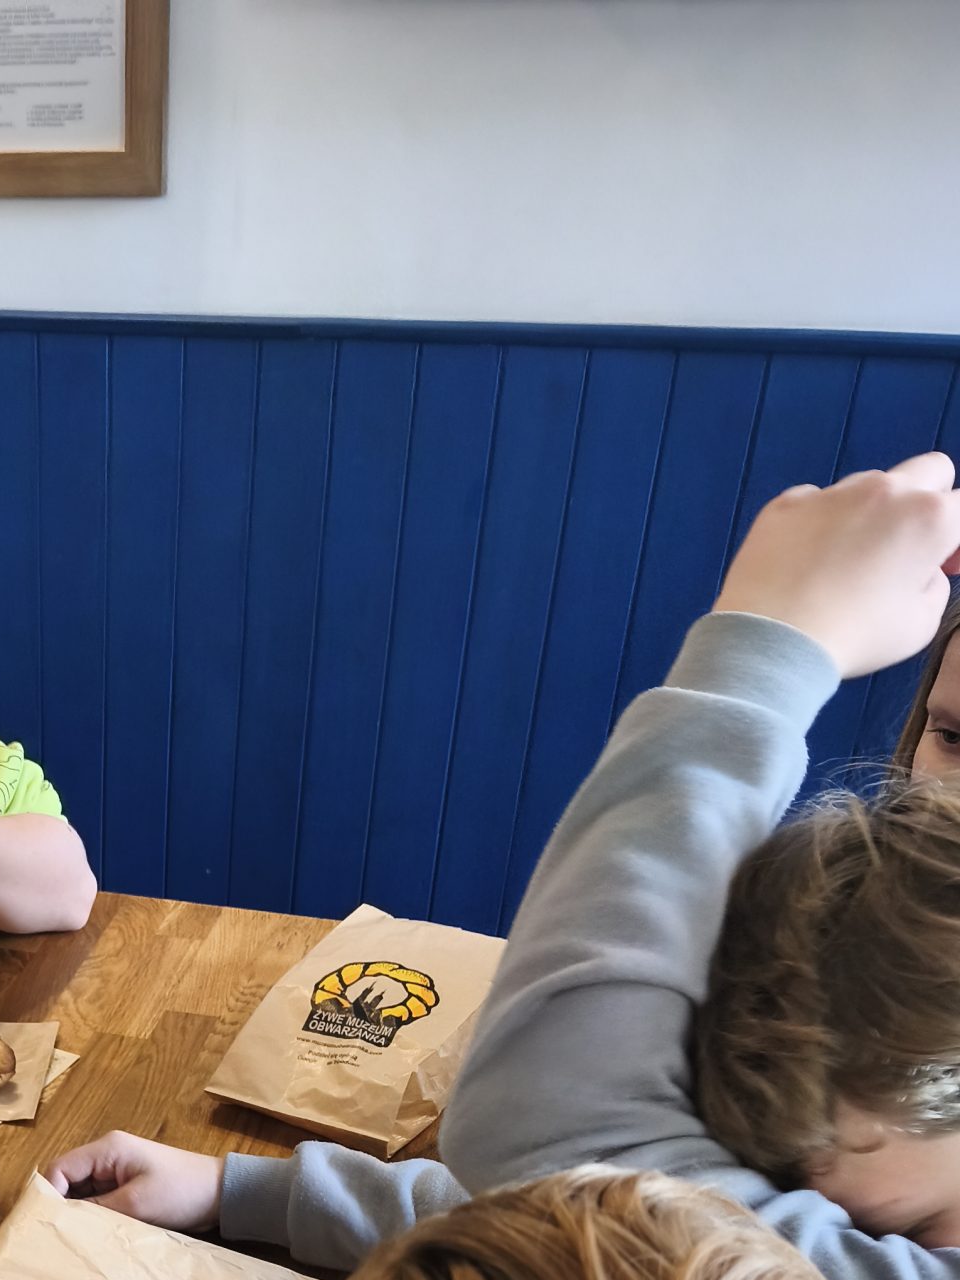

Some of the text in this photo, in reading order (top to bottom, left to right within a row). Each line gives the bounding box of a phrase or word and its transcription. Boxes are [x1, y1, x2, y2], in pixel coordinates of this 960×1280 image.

[308, 1019, 387, 1046] OBWARZANKA
[313, 1009, 393, 1037] ŻYWE MUZEUM
